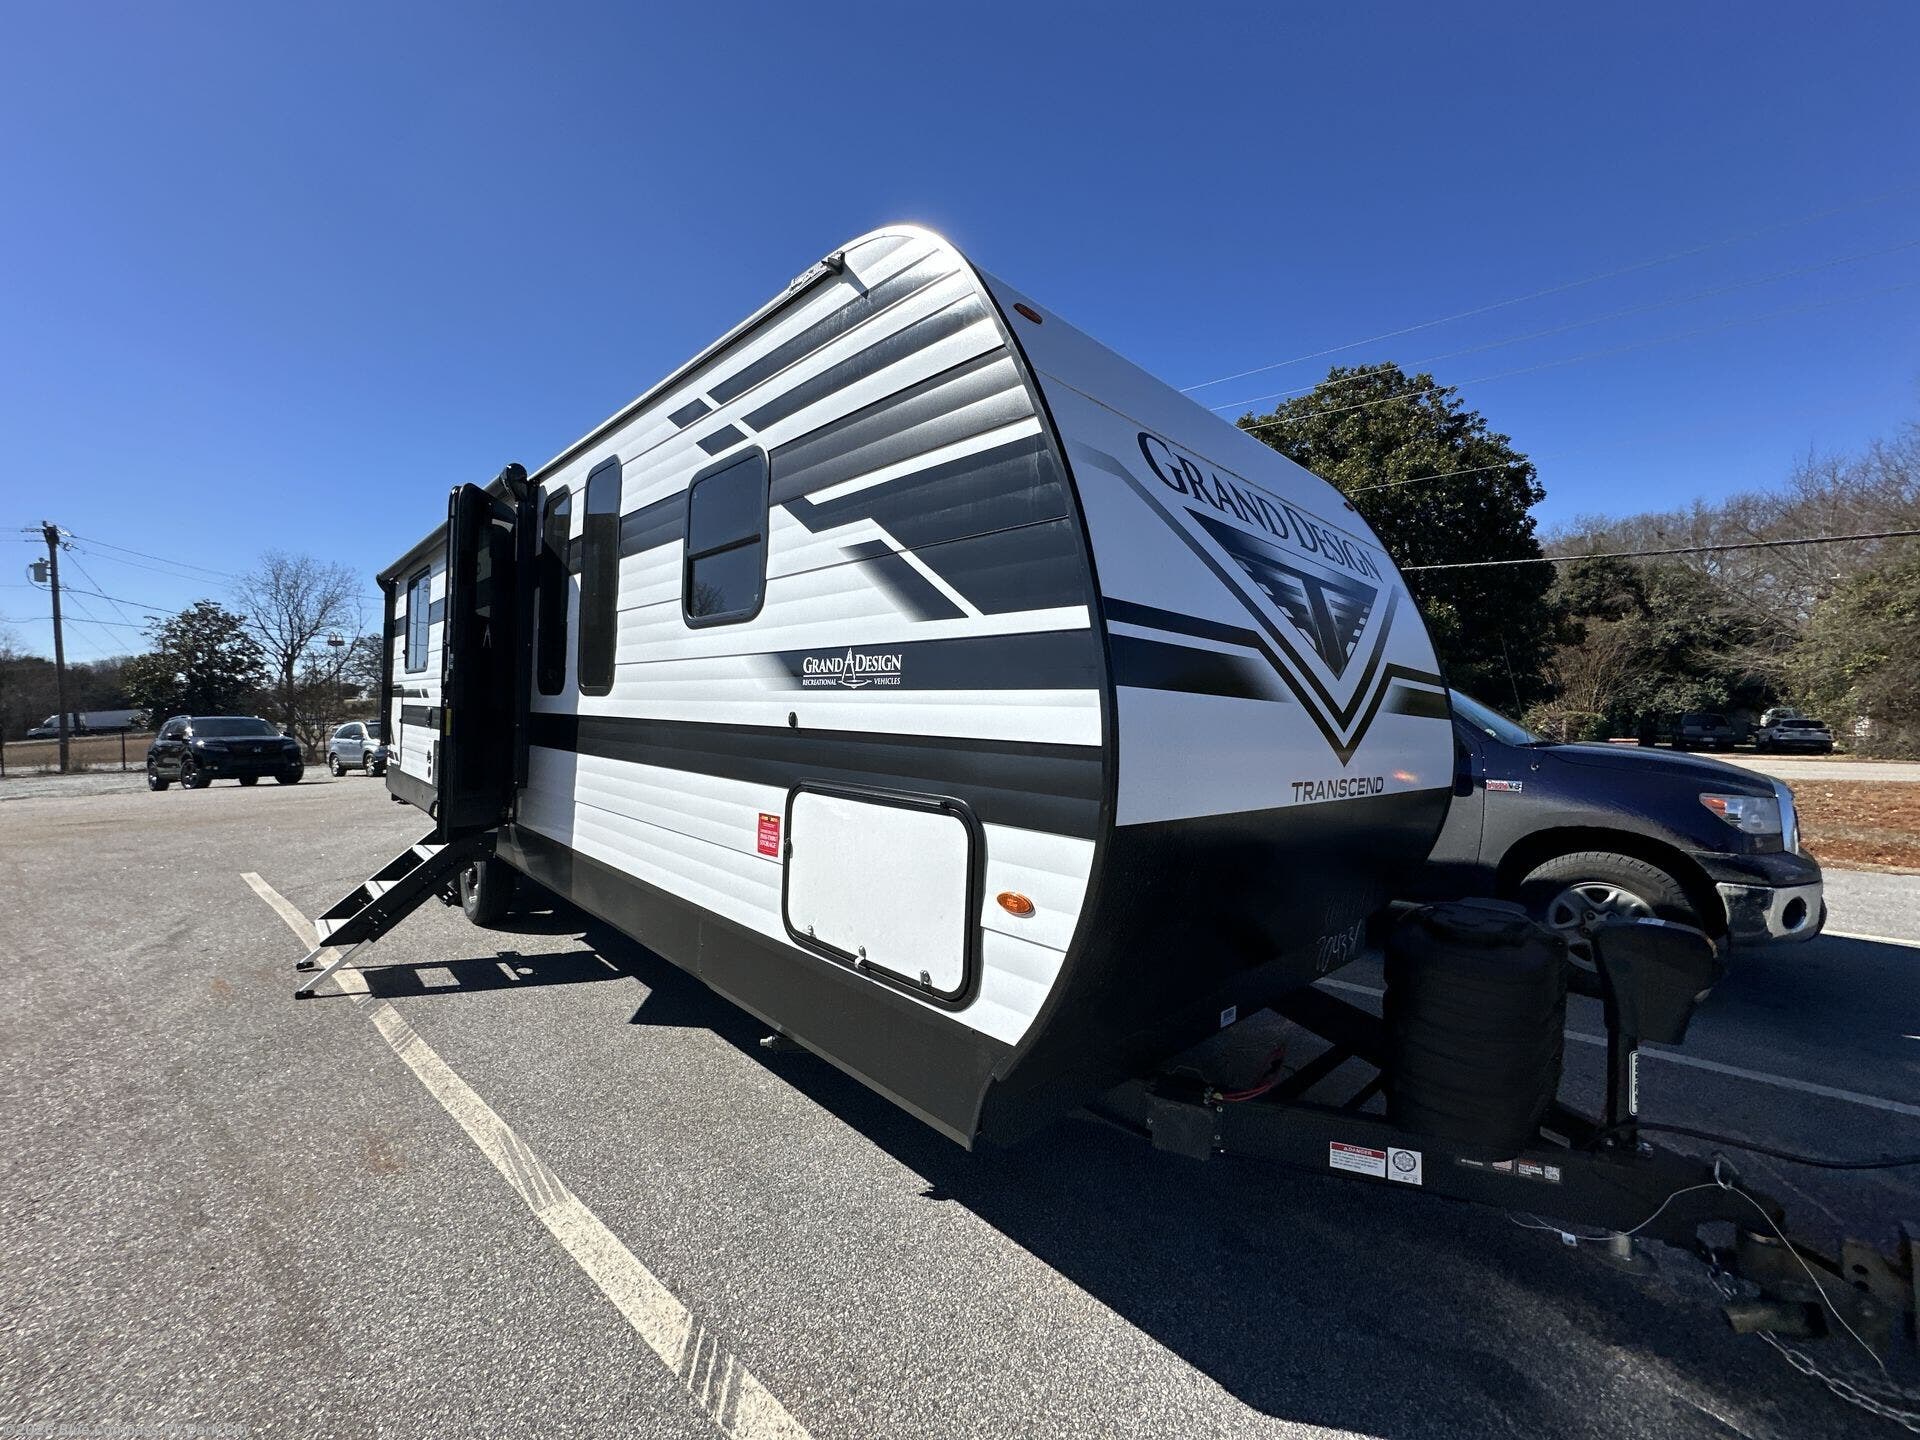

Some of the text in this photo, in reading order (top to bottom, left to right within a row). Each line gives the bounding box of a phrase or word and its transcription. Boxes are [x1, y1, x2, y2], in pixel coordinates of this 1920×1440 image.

[1137, 432, 1384, 583] GRAND DESIGN
[802, 654, 903, 674] GRAND DESIGN
[802, 677, 901, 686] RECREATIONAL VEHICLES
[1292, 776, 1384, 803] TRANSCEND
[1348, 1147, 1373, 1157] DANGER
